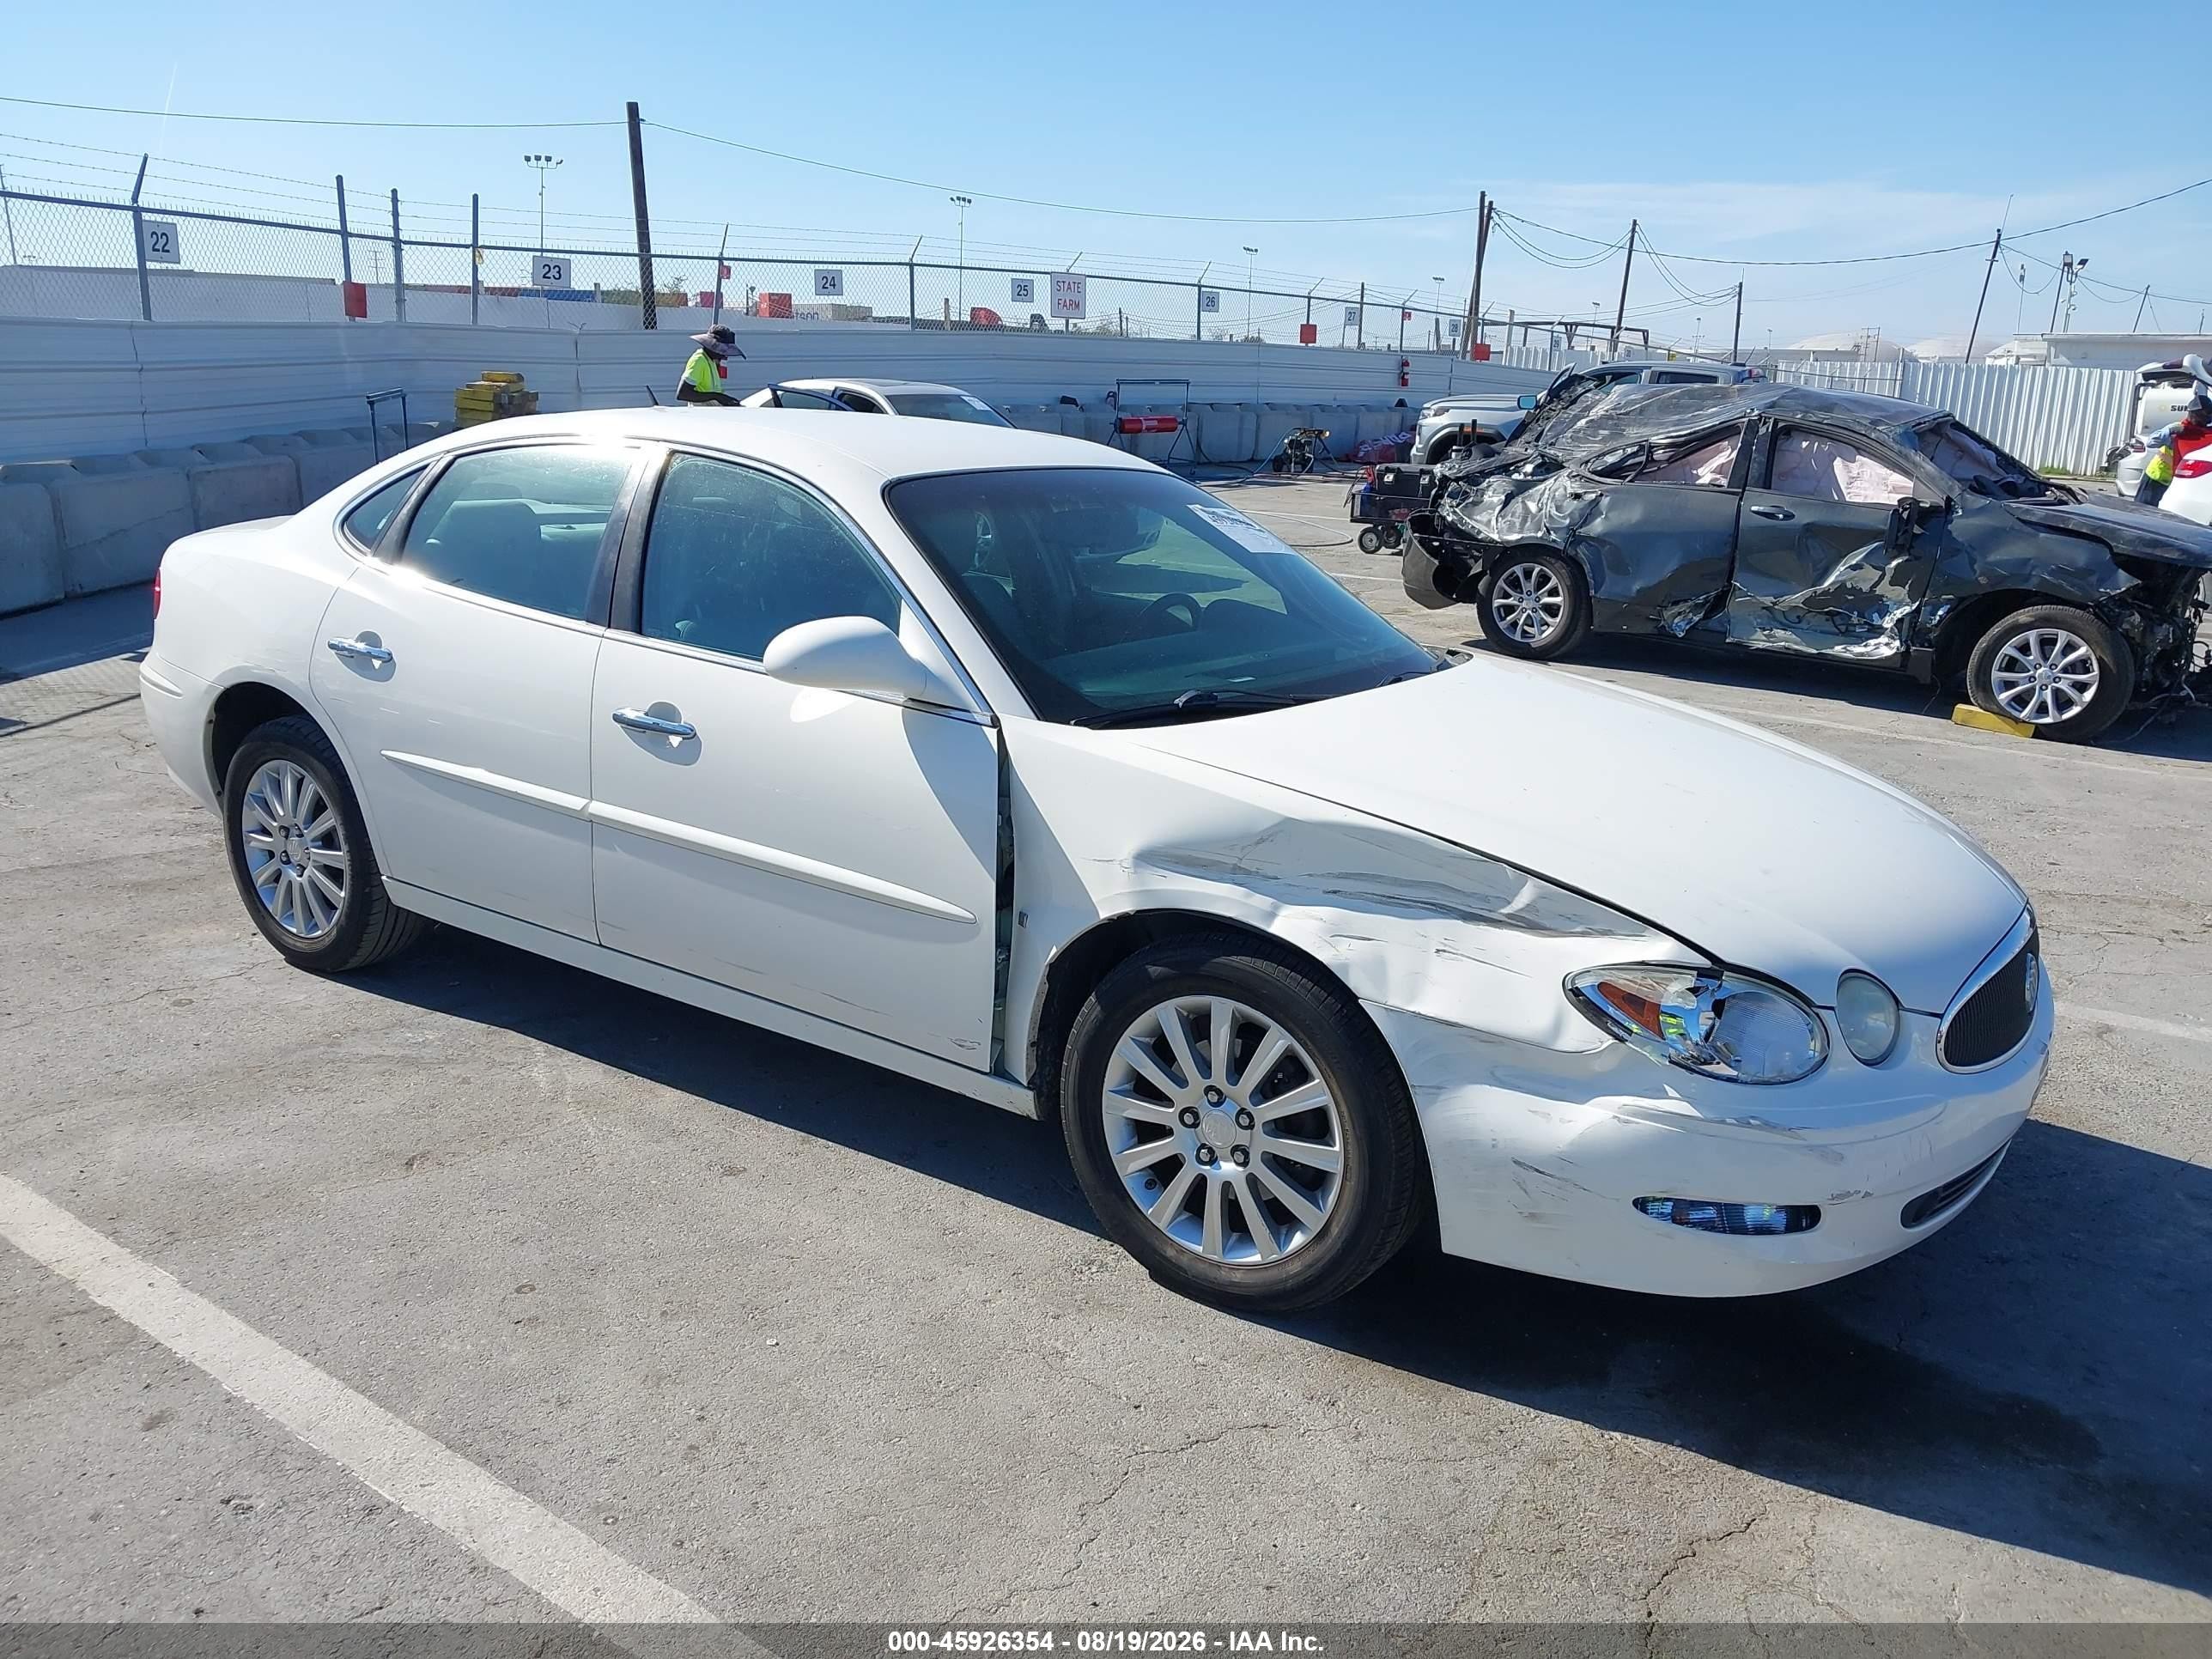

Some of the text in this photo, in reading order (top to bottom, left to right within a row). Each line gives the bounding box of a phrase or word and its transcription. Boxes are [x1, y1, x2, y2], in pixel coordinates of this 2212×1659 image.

[150, 230, 171, 253] 22
[542, 264, 562, 281] 23
[821, 276, 837, 289] 24
[1055, 281, 1082, 294] STATE
[1016, 284, 1029, 297] 25
[1057, 298, 1080, 311] FARM
[1206, 295, 1216, 307] 26
[1347, 311, 1357, 322] 27
[1451, 323, 1458, 333] 28
